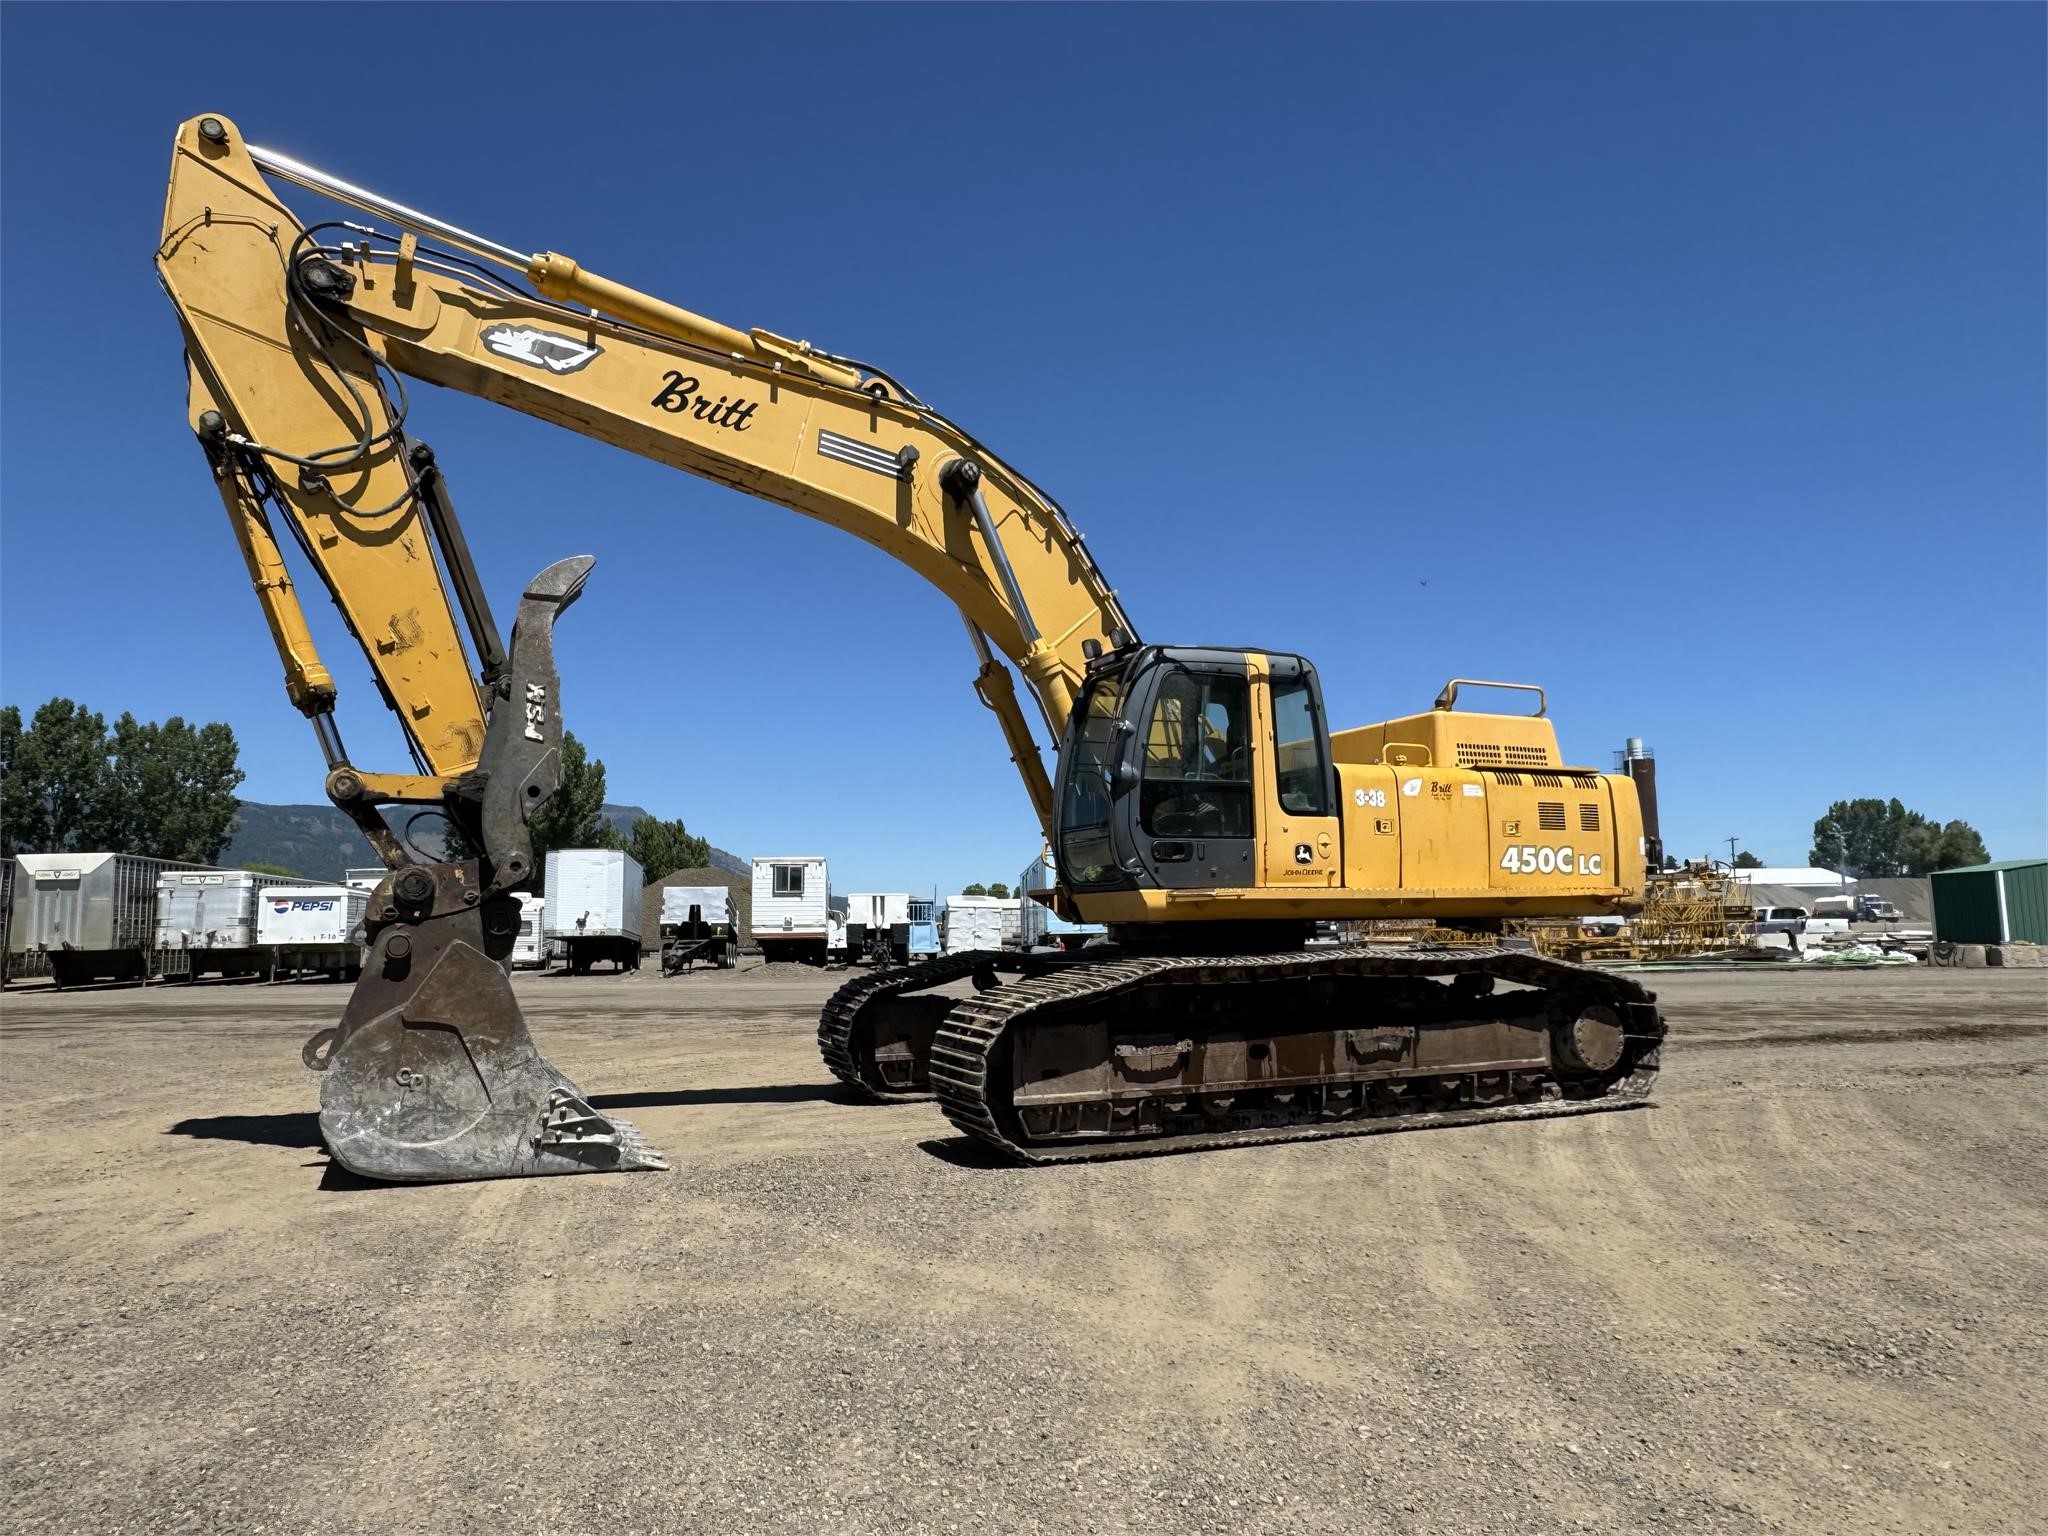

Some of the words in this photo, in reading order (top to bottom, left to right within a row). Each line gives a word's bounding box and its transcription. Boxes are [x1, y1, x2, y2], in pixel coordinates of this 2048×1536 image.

[651, 370, 759, 431] Britt
[1500, 845, 1574, 875] 450C
[1578, 854, 1601, 875] LC
[291, 901, 334, 911] PEPSI
